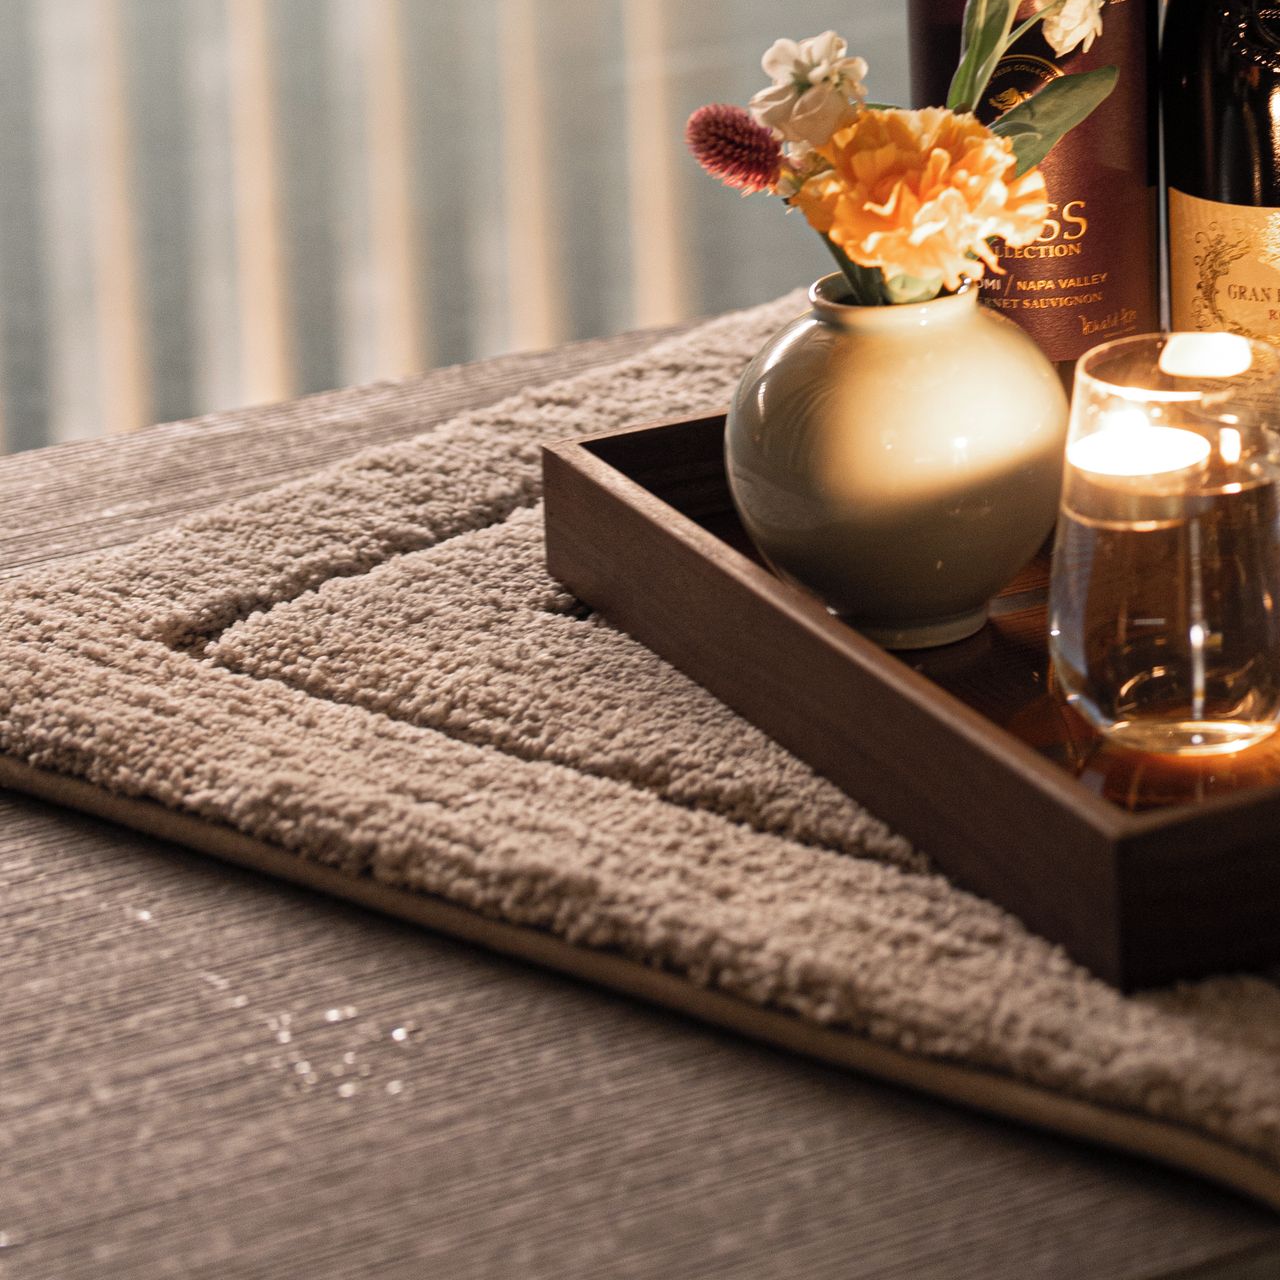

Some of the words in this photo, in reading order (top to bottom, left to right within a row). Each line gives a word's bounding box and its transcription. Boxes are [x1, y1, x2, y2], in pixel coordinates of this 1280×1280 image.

[1036, 200, 1088, 242] SS
[993, 243, 1082, 258] LLECTION
[1016, 278, 1056, 292] NAPA
[1057, 272, 1108, 289] VALLEY
[1022, 293, 1103, 309] SAUVIGNON
[1227, 283, 1272, 303] GRAN
